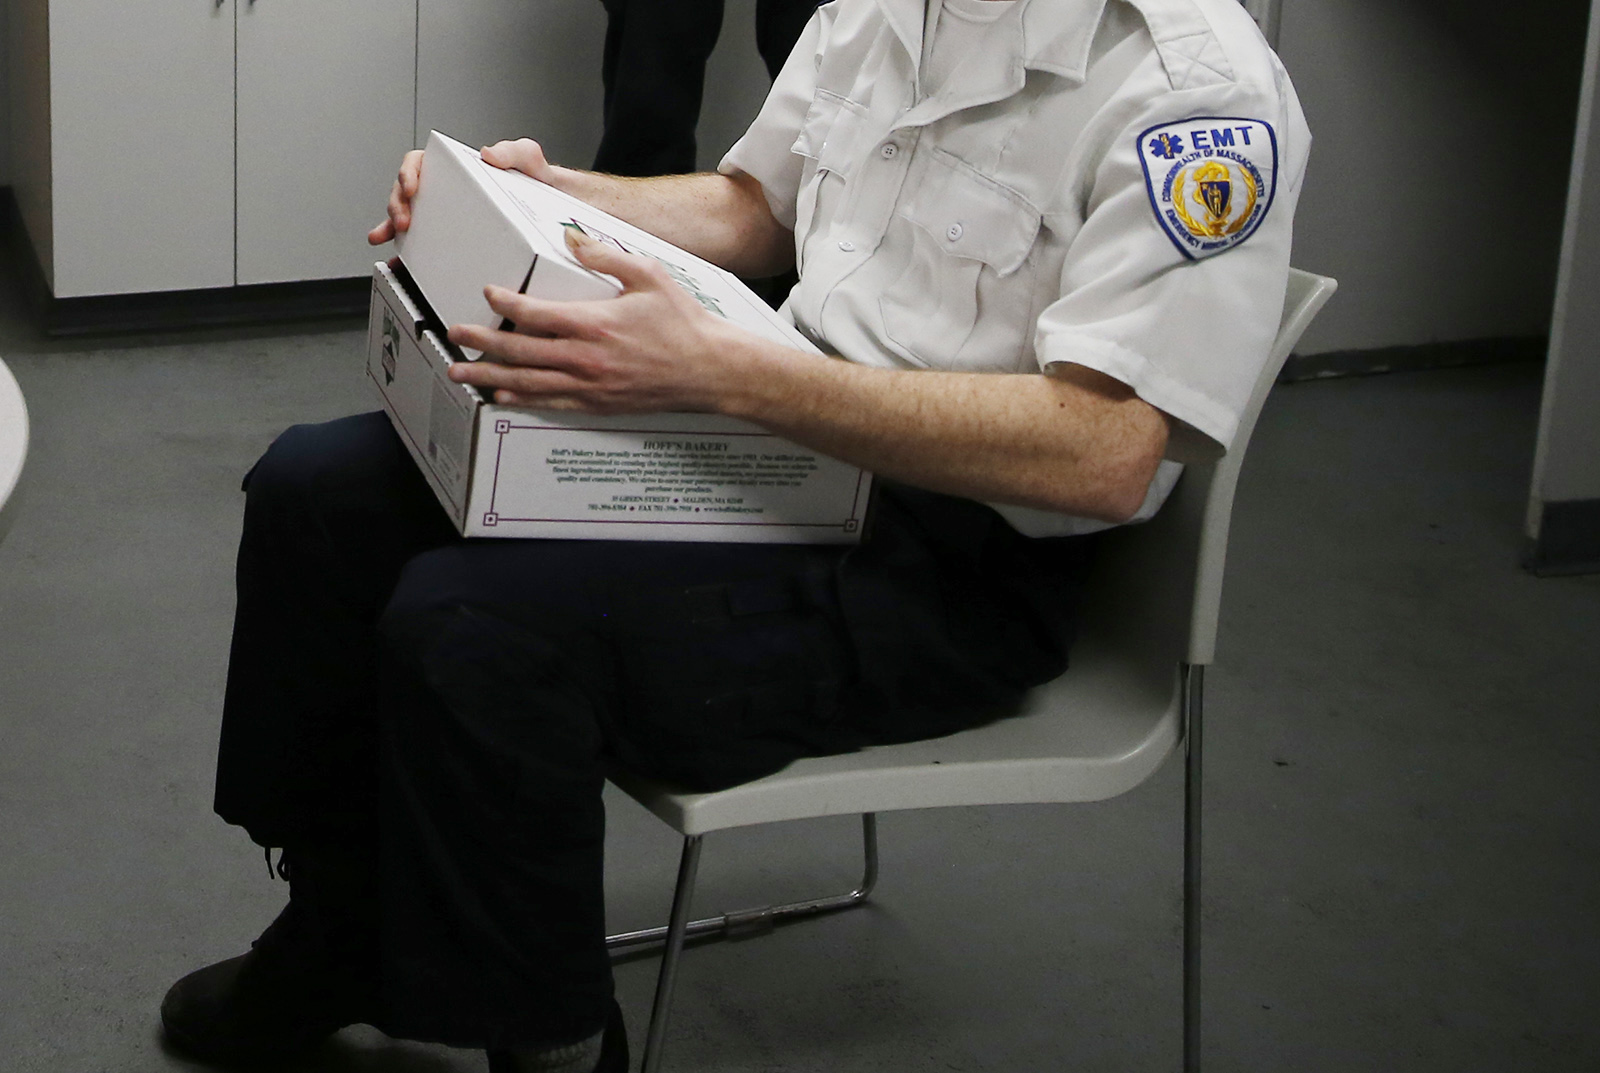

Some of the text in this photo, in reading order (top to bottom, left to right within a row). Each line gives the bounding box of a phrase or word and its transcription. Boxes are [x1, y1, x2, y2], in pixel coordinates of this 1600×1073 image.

[1190, 126, 1253, 150] EMT
[1204, 149, 1215, 158] OF
[1216, 149, 1265, 198] MASSACHUSETTS
[1165, 209, 1200, 249] EMERGENCY
[643, 440, 730, 452] HOFF'S BAKERY
[551, 448, 571, 456] Hoff's
[572, 449, 594, 457] Bakery
[606, 450, 631, 458] proudly
[570, 467, 603, 475] ingredients
[604, 467, 616, 475] and
[616, 468, 642, 477] properly
[557, 476, 578, 484] quality
[619, 495, 643, 503] GREEN
